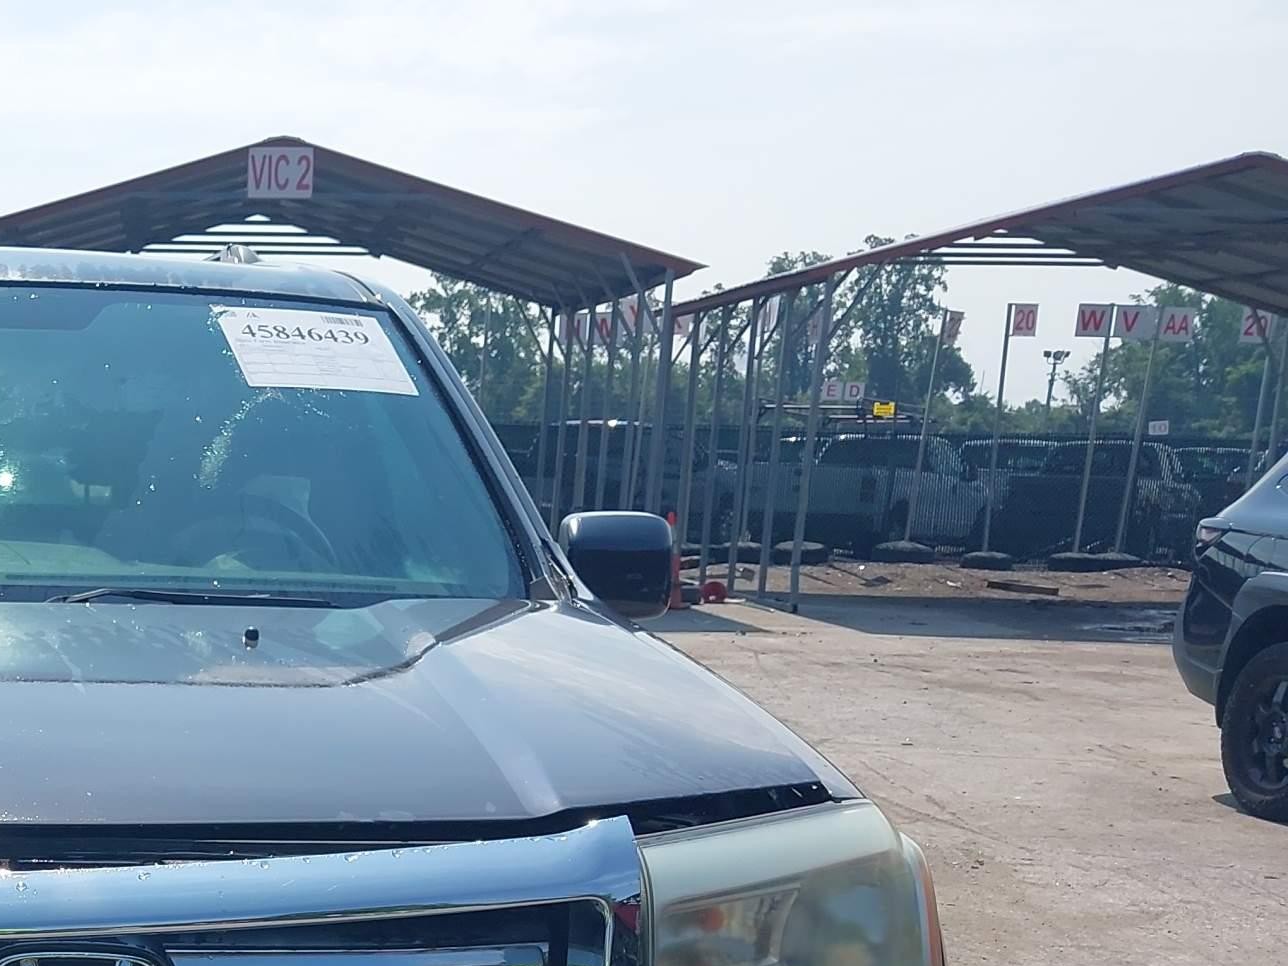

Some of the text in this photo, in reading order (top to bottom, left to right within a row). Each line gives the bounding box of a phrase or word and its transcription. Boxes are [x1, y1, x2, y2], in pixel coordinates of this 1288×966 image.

[251, 154, 311, 191] VIC 2
[1015, 310, 1036, 331] 20
[1080, 310, 1106, 331] W
[1123, 311, 1140, 332] V
[1163, 313, 1190, 335] AA
[242, 324, 369, 345] 45846439
[826, 384, 838, 397] E
